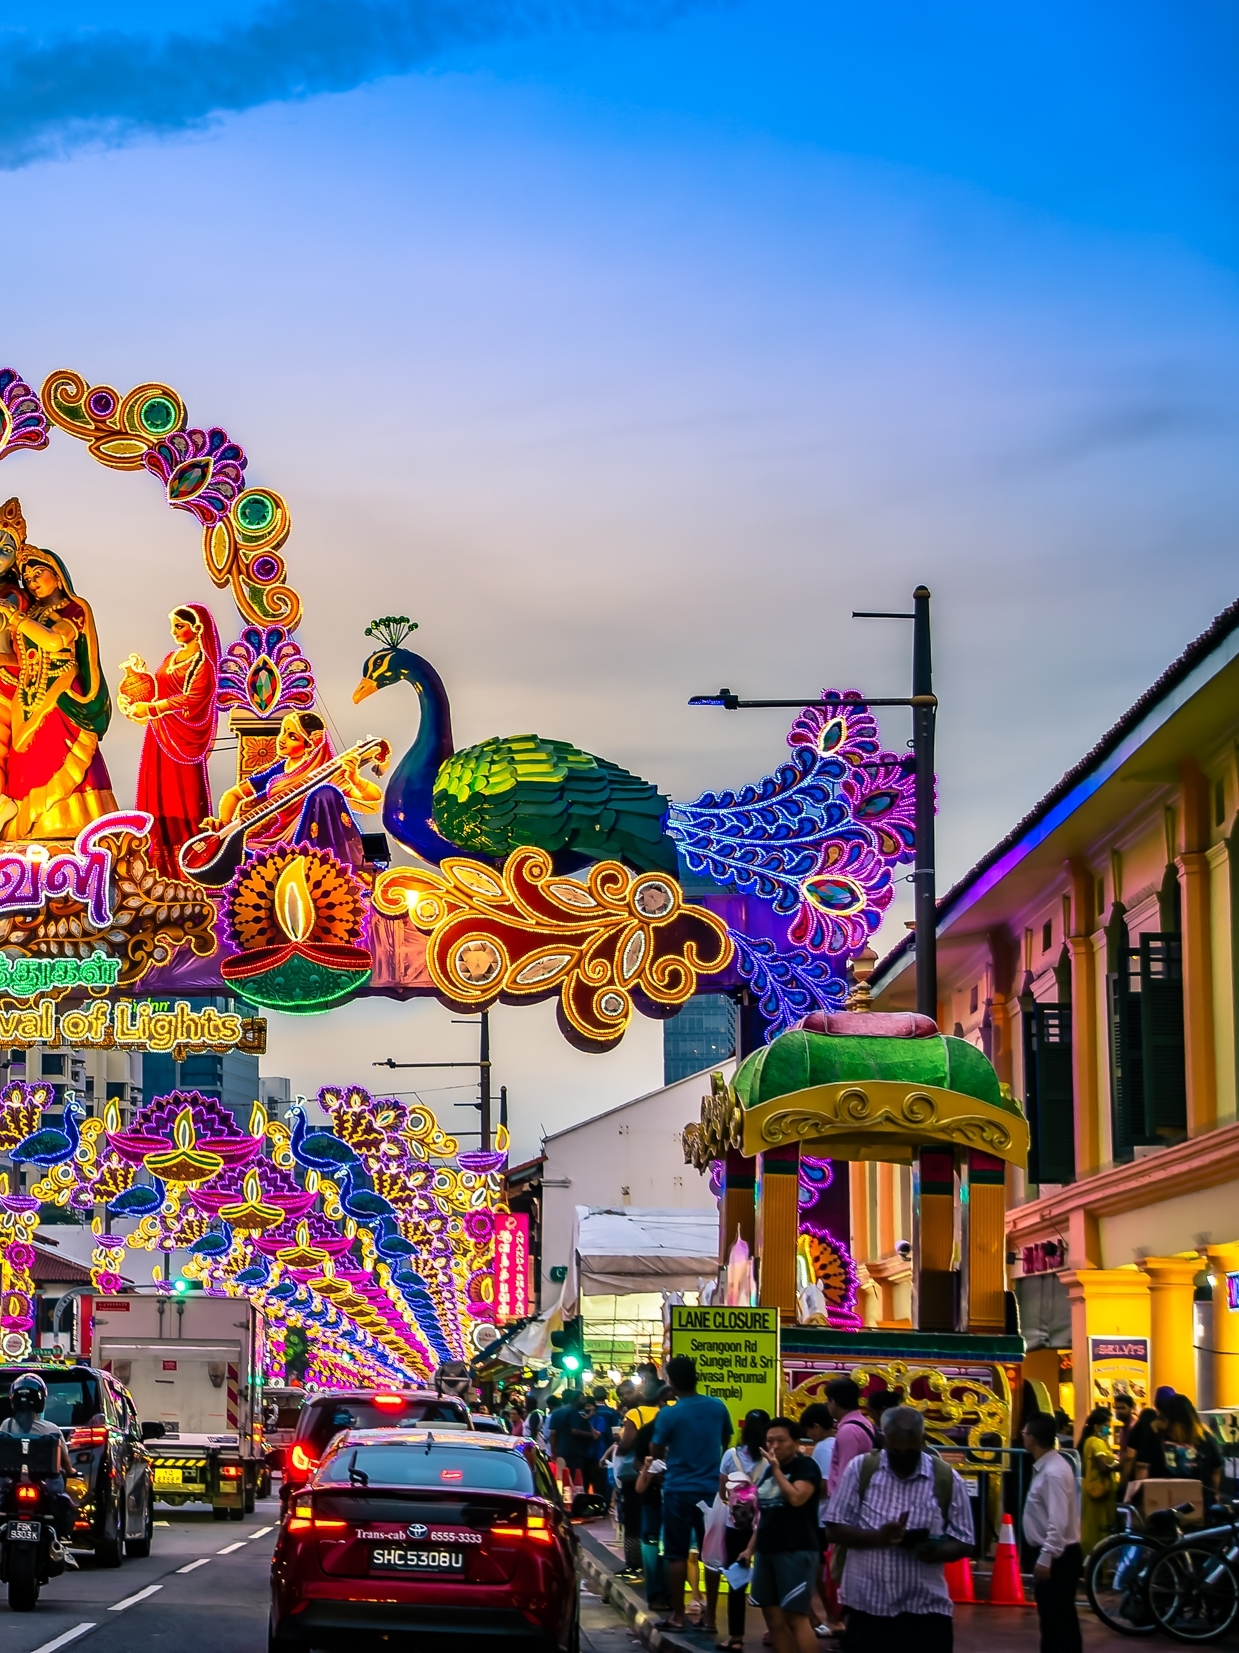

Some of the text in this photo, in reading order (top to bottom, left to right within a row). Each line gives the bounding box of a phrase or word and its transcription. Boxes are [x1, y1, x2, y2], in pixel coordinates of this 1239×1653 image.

[63, 1000, 110, 1042] of
[115, 1000, 242, 1052] Lights
[515, 1230, 525, 1315] ANANDA BHAVAN
[678, 1311, 769, 1329] LANE CLOSURE
[691, 1338, 757, 1354] Serangoon Rd
[699, 1354, 732, 1370] Sungei
[735, 1355, 748, 1368] Rd
[750, 1355, 758, 1368] &
[760, 1355, 773, 1369] Sri
[727, 1370, 767, 1384] Perumal
[704, 1385, 743, 1401] Temple)
[355, 1529, 406, 1540] Trans-cab
[430, 1531, 482, 1544] 6555-3333
[373, 1549, 462, 1567] SHC5308U
